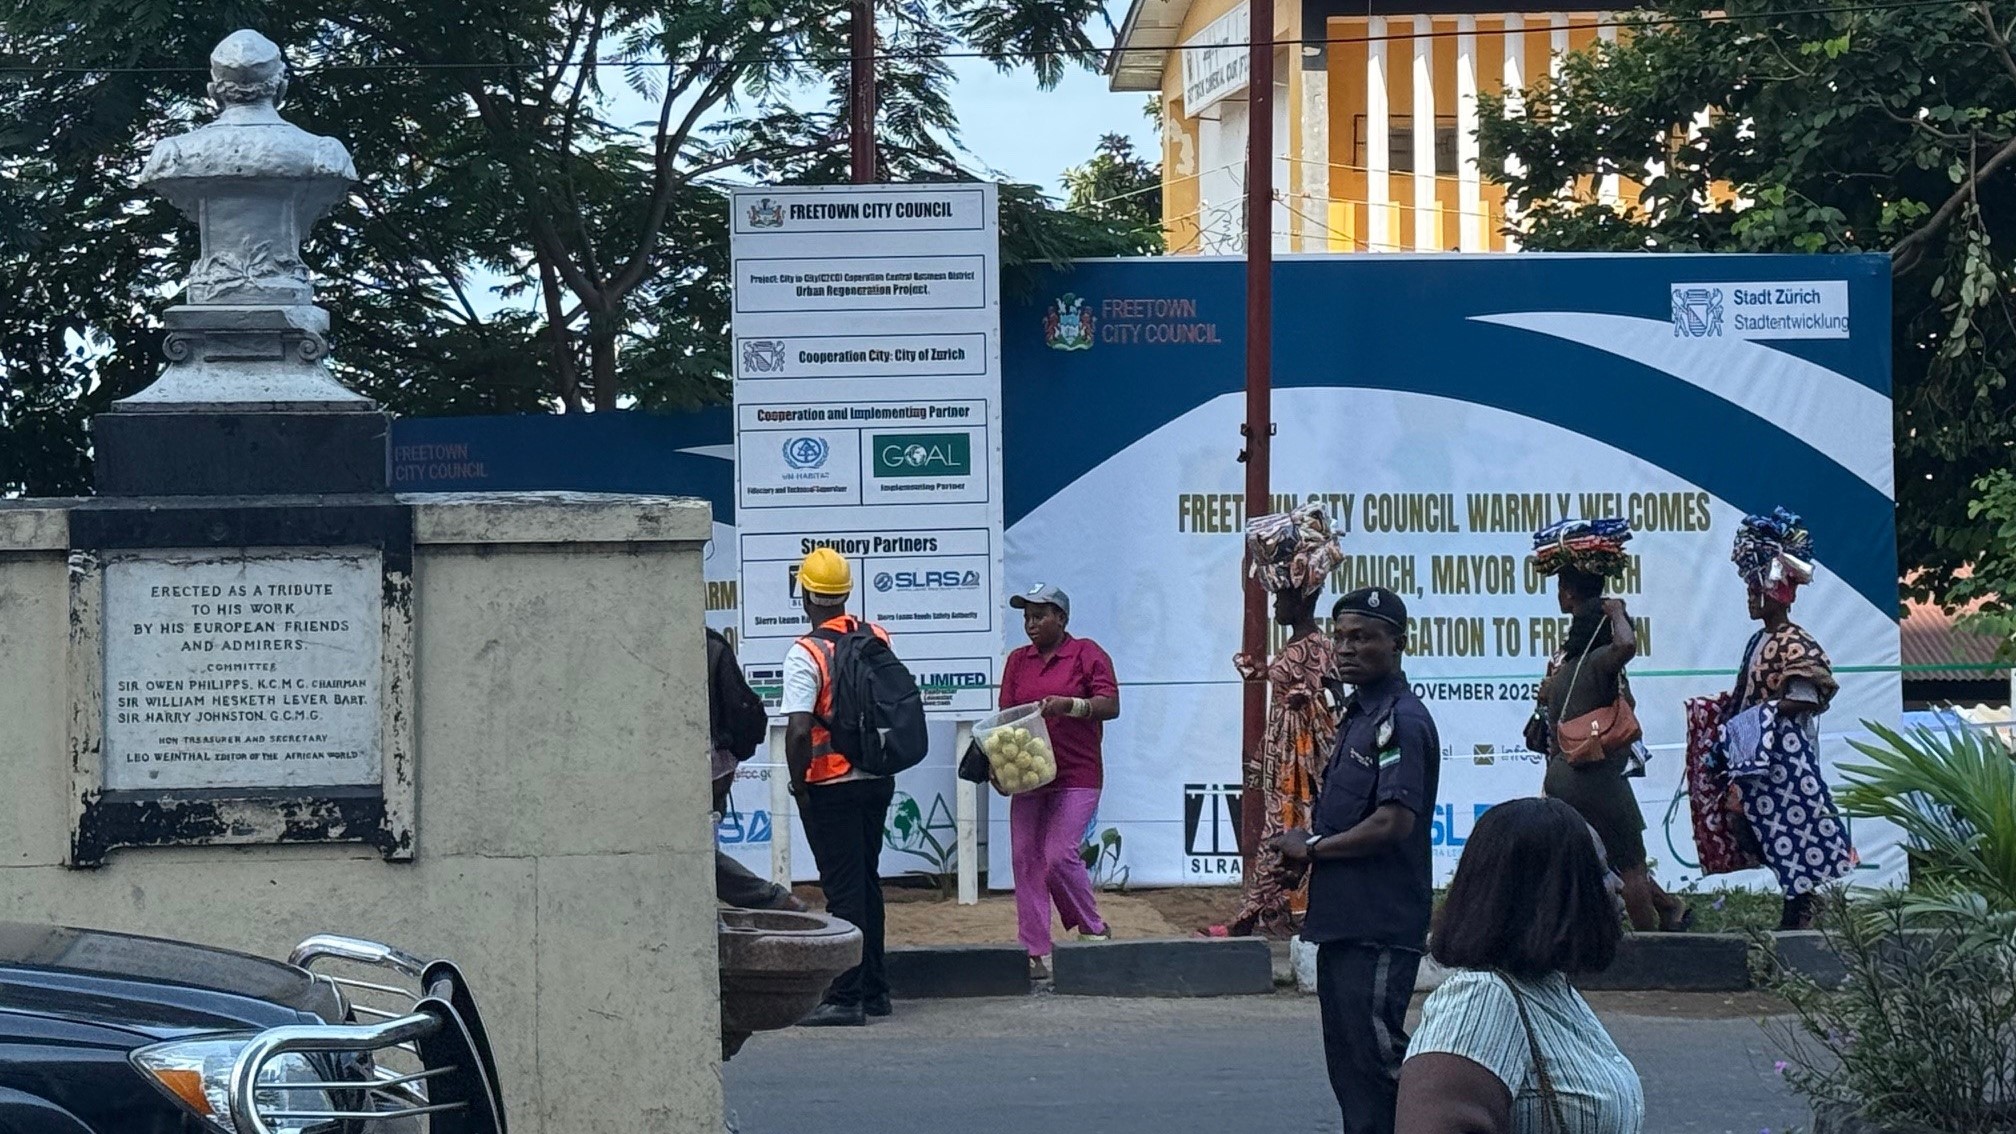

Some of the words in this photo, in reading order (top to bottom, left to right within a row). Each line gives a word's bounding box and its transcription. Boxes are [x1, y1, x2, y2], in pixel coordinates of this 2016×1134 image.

[790, 204, 859, 220] FREETOWN
[862, 203, 892, 218] CITY
[896, 202, 952, 218] COUNCIL
[796, 286, 824, 297] Urban
[826, 284, 891, 298] Regeneration
[1734, 289, 1772, 304] Stadt
[1775, 288, 1820, 304] Zürich
[1102, 299, 1196, 319] FREETOWN
[1734, 314, 1850, 332] Stadtentwicklung
[1102, 324, 1142, 344] CITY
[1146, 324, 1222, 344] COUNCIL
[799, 350, 866, 364] Cooperation
[868, 350, 893, 363] City:
[894, 349, 916, 362] City
[918, 349, 930, 360] of
[931, 348, 965, 360] Zurich
[758, 408, 826, 422] Cooperation
[828, 408, 848, 420] and
[850, 407, 926, 421] Implementing
[929, 406, 970, 418] Partner
[394, 444, 468, 462] FREETOWN
[882, 444, 960, 468] GOAL
[395, 464, 426, 481] CITY
[430, 462, 488, 479] COUNCIL
[880, 484, 934, 492] Implementing
[1364, 493, 1460, 532] COUNCIL
[1578, 492, 1712, 532] WELCOMES
[802, 538, 870, 556] Statutory
[874, 536, 938, 552] Partners
[1331, 555, 1424, 600] MAUCH,
[1432, 555, 1516, 594] MAYOR
[150, 586, 222, 598] ERECTED
[228, 585, 246, 596] AS
[253, 585, 263, 596] A
[268, 584, 333, 596] TRIBUTE
[191, 604, 210, 616] TO
[217, 603, 242, 615] HIS
[250, 603, 296, 614] WORK
[134, 623, 153, 635] BY
[160, 623, 184, 634] HIS
[194, 621, 275, 634] EUROPEAN
[285, 620, 349, 632] FRIENDS
[755, 616, 776, 626] Sierra
[1406, 617, 1485, 657] GATION
[1492, 617, 1521, 657] TO
[181, 640, 214, 652] AND
[221, 639, 308, 651] ADMIRERS.
[207, 663, 277, 672] COMMITTEE
[118, 680, 139, 692] SIR
[146, 680, 184, 691] OWEN
[312, 679, 366, 688] CHAIRMAN
[920, 672, 986, 686] LIMITED
[1498, 683, 1540, 700] 2025
[118, 697, 139, 708] SIR
[146, 696, 204, 707] WILLIAM
[212, 695, 275, 706] HESKETH
[283, 694, 328, 705] LEVER
[334, 694, 367, 705] BART.
[118, 712, 140, 723] SIR
[144, 712, 191, 723] HARRY
[158, 736, 178, 744] HON
[184, 735, 241, 744] TREASURER
[245, 735, 266, 743] AND
[270, 734, 328, 743] SECRETARY
[127, 752, 150, 762] LEO
[154, 752, 210, 762] WEINTHAL
[215, 752, 247, 760] EDITOR
[250, 752, 260, 760] OF
[262, 752, 278, 760] THE
[284, 752, 324, 760] AFRICAN
[1191, 858, 1240, 874] SLRA
